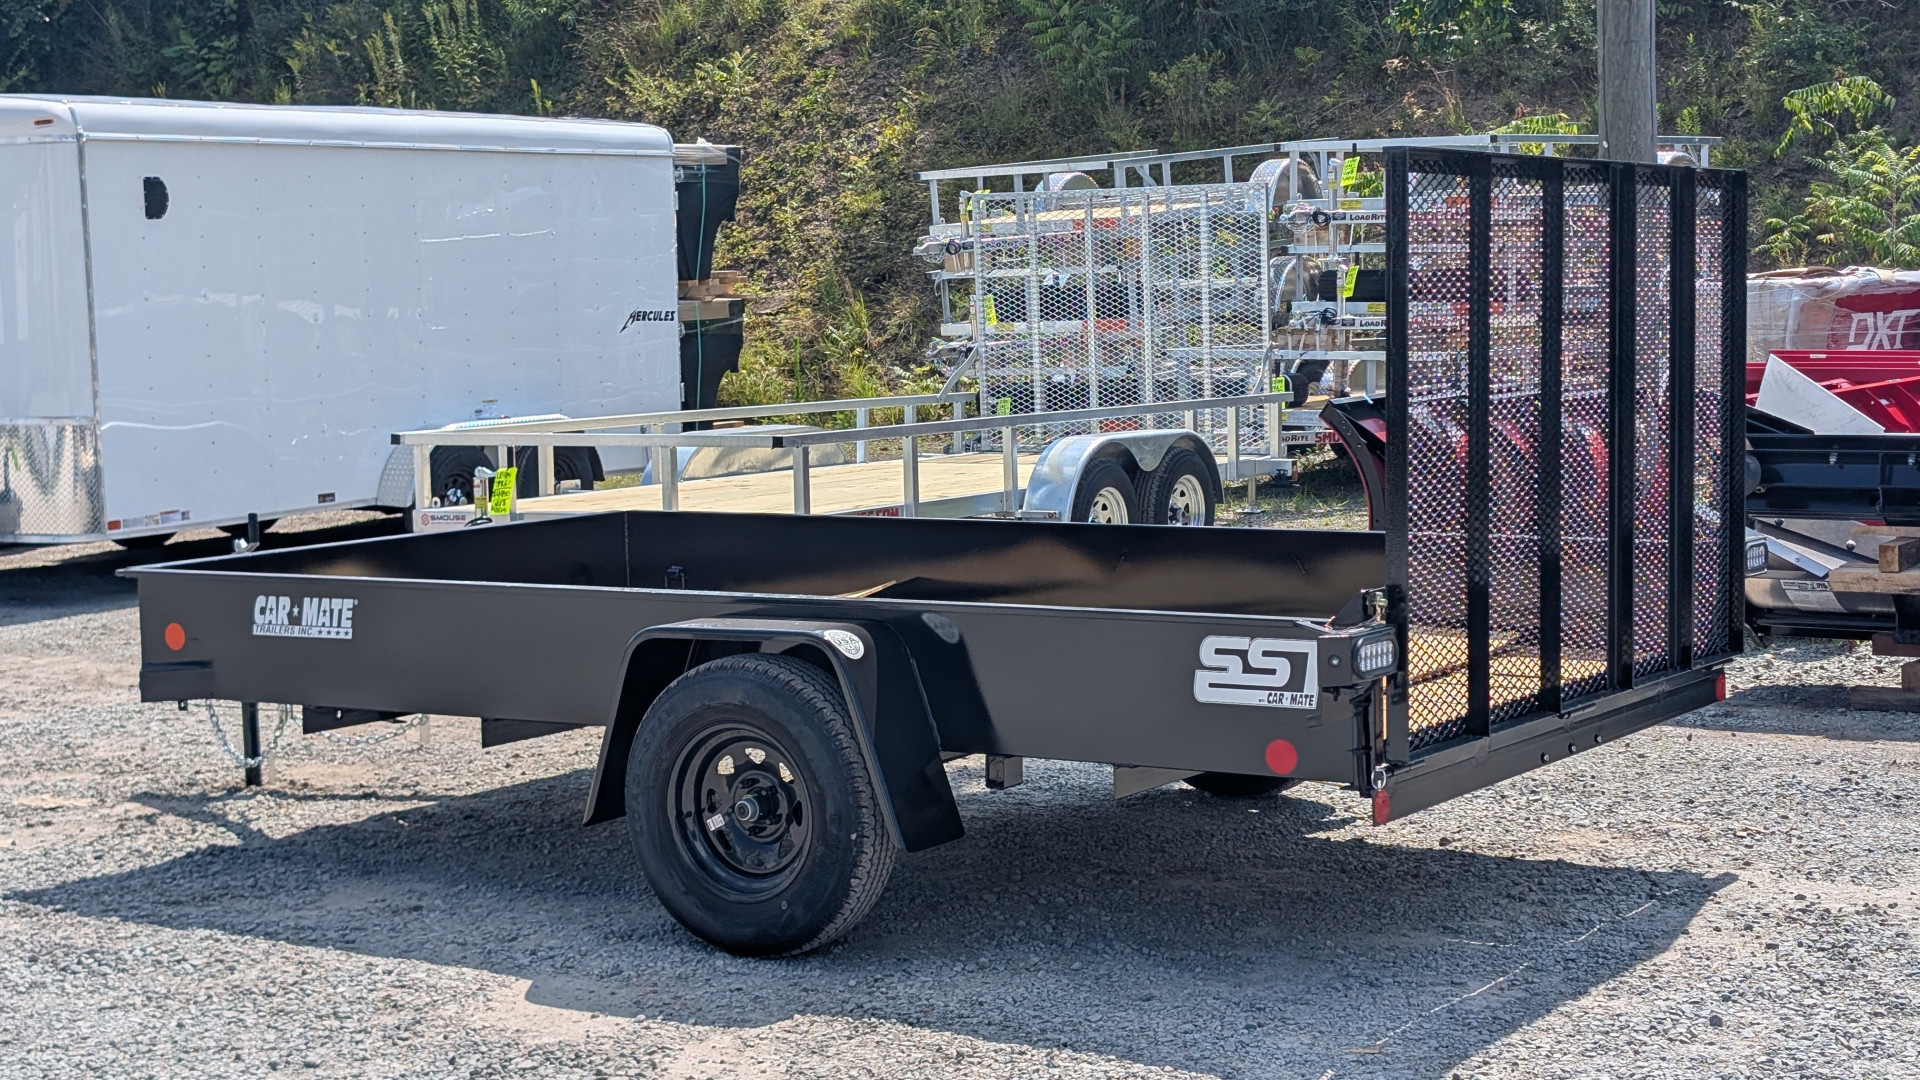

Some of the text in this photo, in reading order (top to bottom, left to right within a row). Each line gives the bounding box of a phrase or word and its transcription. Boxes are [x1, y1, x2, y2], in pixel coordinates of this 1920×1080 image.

[1350, 213, 1385, 221] LOADRIT
[619, 307, 676, 334] HERCULES
[254, 595, 353, 627] CAR MATE
[255, 625, 315, 636] TRAILERS INC.
[1267, 692, 1284, 705] CAR
[1290, 694, 1315, 707] MATE
